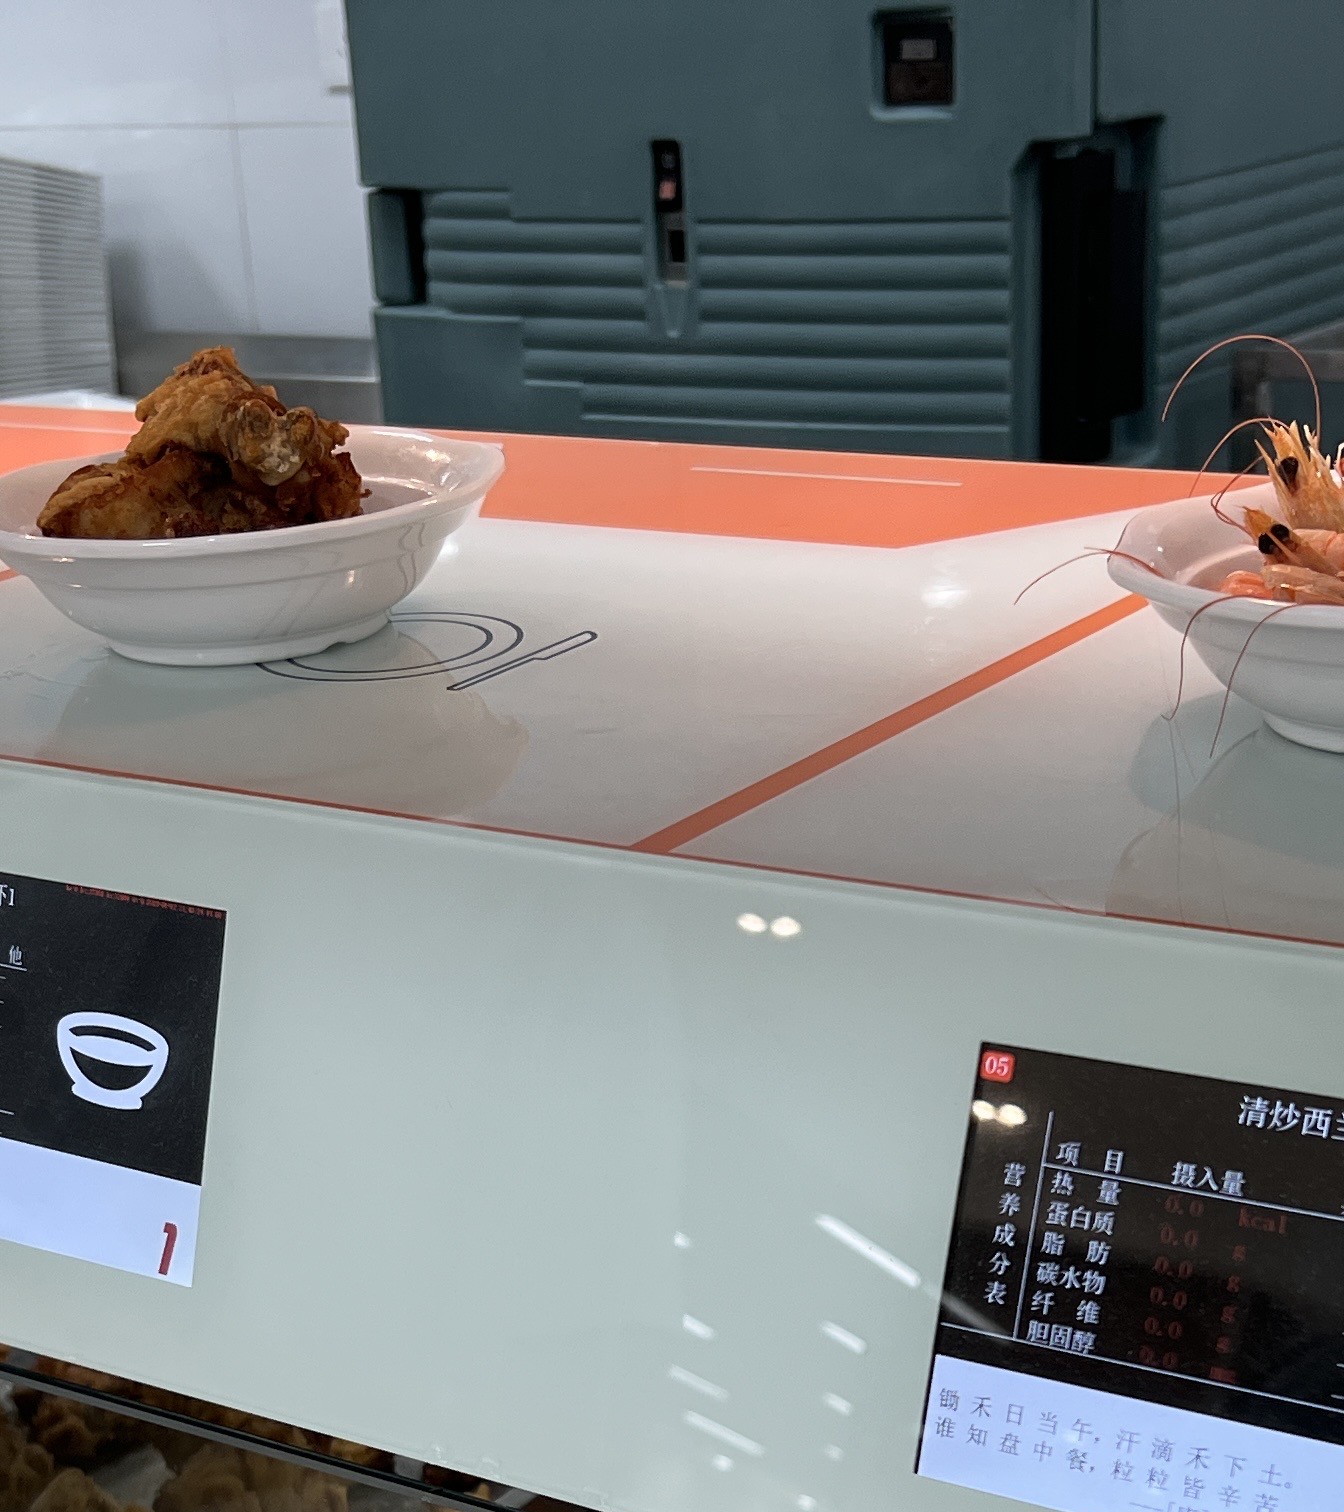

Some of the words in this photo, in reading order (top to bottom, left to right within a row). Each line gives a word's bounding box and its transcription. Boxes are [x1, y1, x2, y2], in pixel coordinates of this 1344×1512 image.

[984, 1056, 1010, 1076] 05
[1055, 1141, 1125, 1175] 项目
[1171, 1161, 1247, 1197] 摄入量
[1050, 1172, 1121, 1206] 热量
[984, 1161, 1027, 1306] 营养成分表
[1044, 1201, 1116, 1237] 蛋白质
[158, 1222, 179, 1276] 1
[1039, 1231, 1112, 1266] 脂肪
[1035, 1261, 1107, 1296] 碳水物
[1030, 1290, 1102, 1326] 纤维
[1025, 1319, 1098, 1356] 胆固醇
